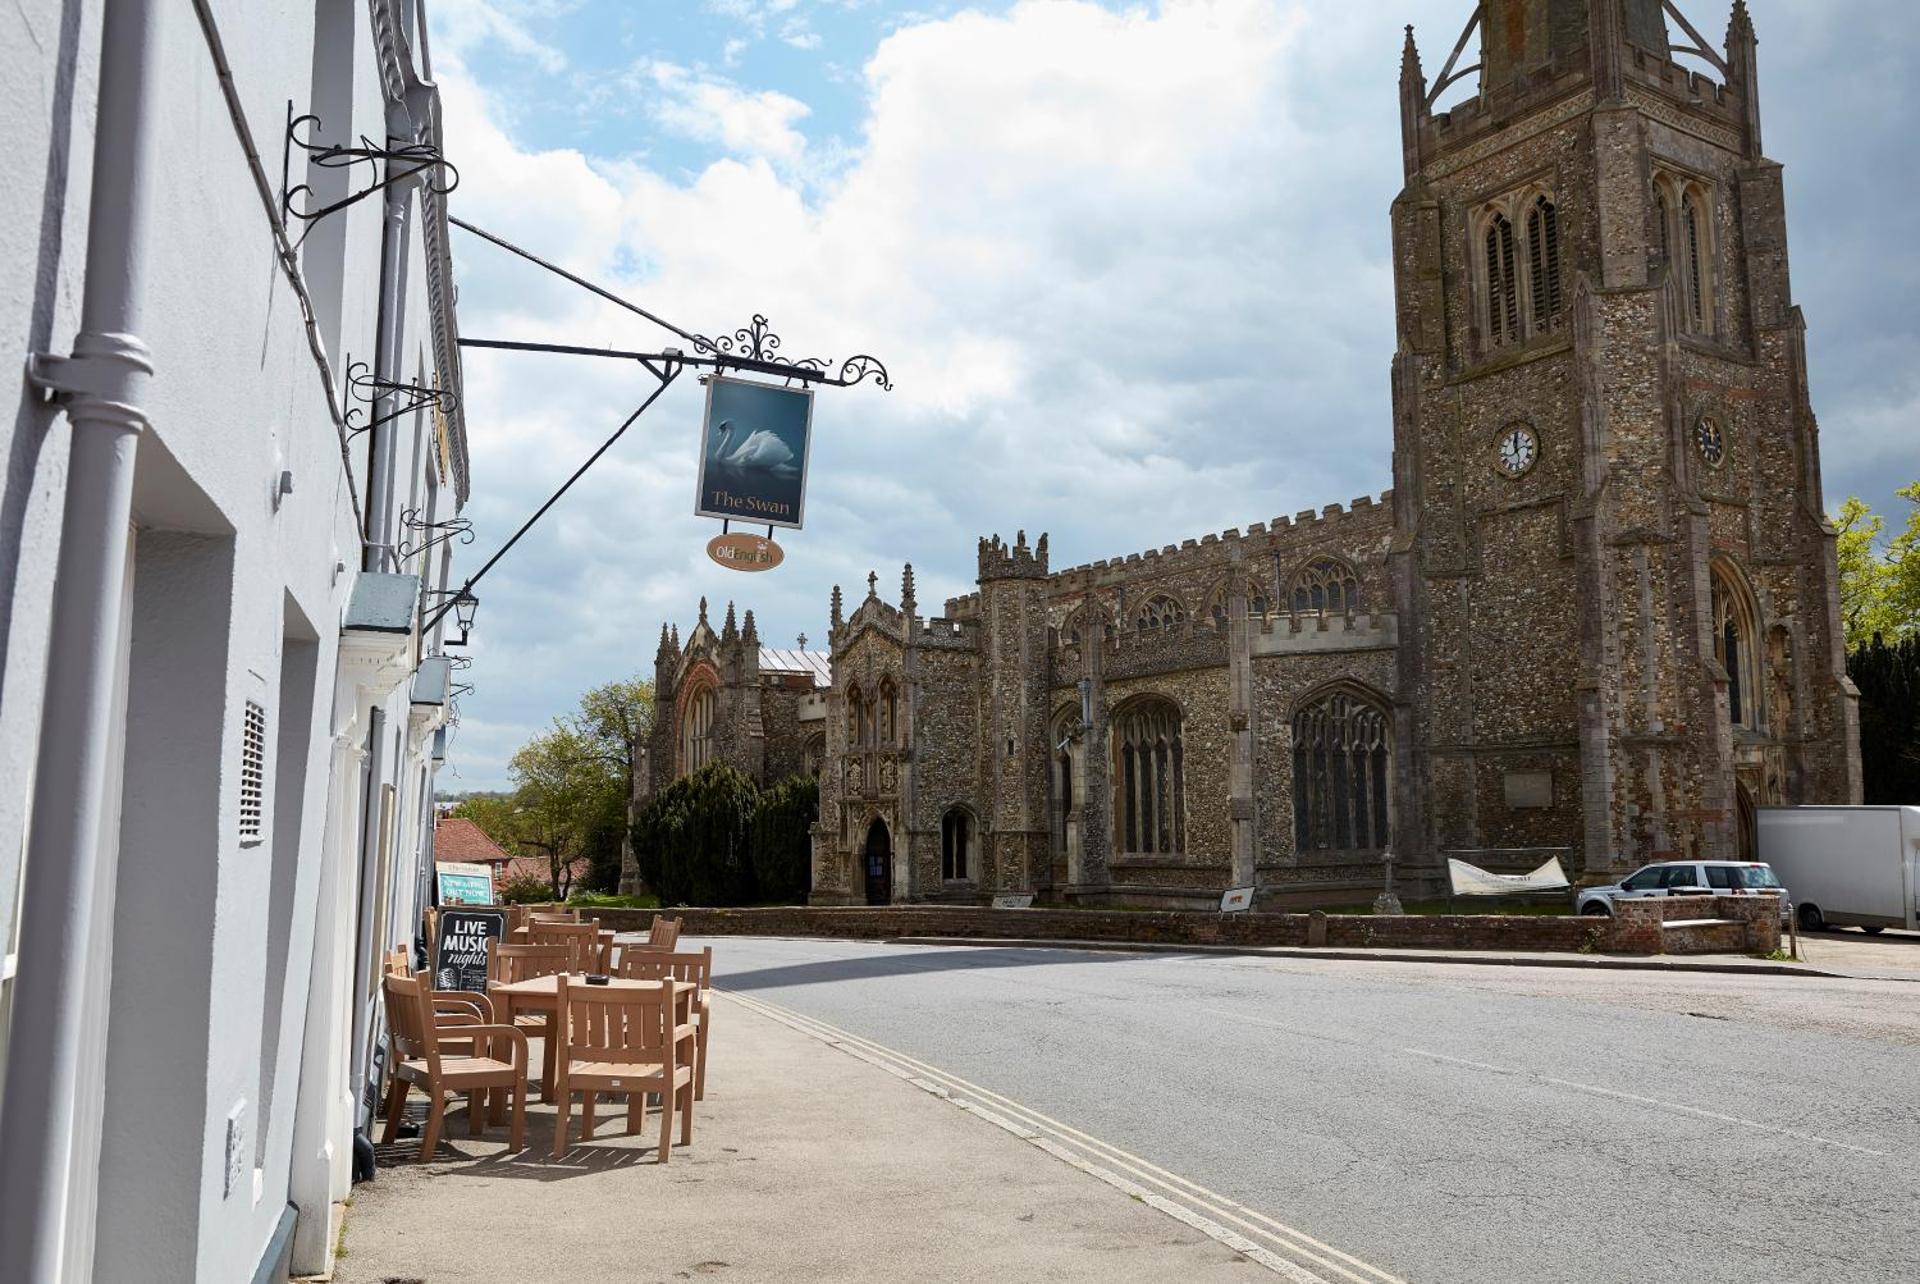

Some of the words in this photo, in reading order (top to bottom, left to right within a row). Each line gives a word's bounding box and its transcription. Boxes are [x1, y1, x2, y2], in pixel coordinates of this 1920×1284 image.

[712, 490, 742, 508] The
[747, 496, 790, 515] Swan
[455, 920, 487, 935] LIVE
[447, 951, 487, 969] nights
